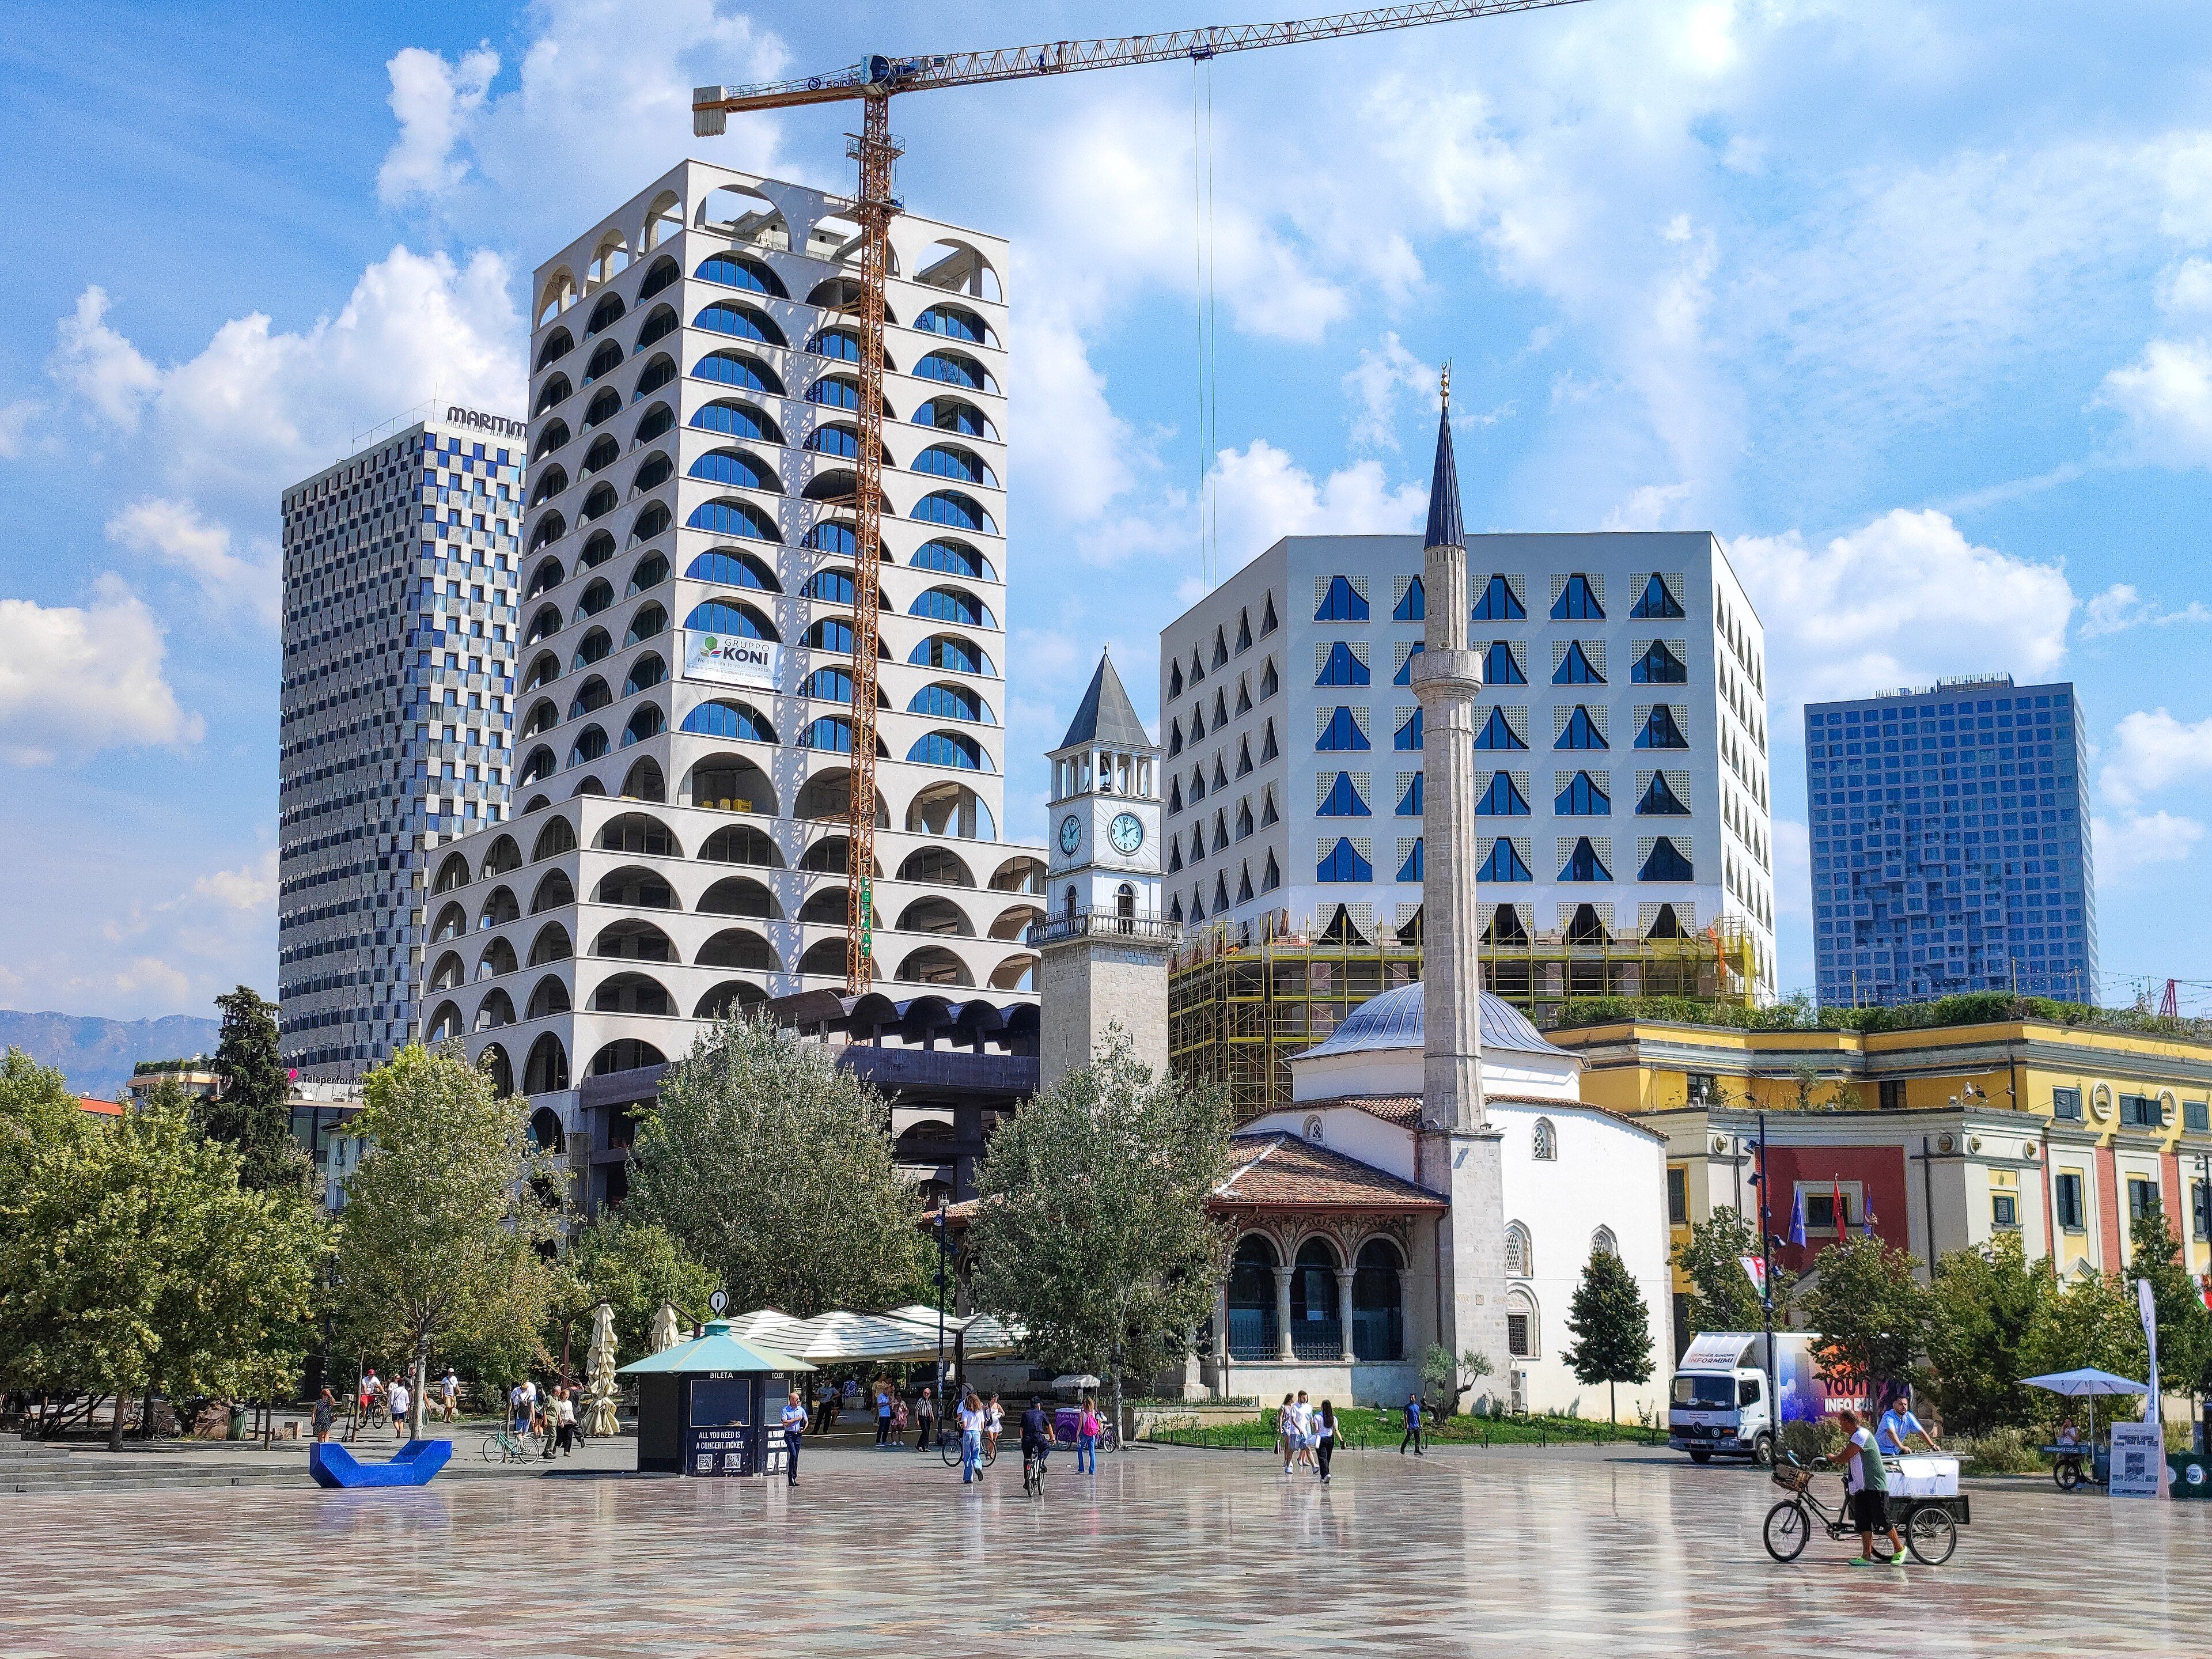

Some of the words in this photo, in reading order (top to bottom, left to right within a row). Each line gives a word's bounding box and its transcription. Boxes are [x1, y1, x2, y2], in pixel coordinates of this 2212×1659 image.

[448, 406, 528, 437] MARITIM
[725, 638, 770, 652] GRUPPO
[723, 647, 768, 665] KONI
[747, 664, 768, 673] projects
[1824, 1397, 1852, 1412] INFO
